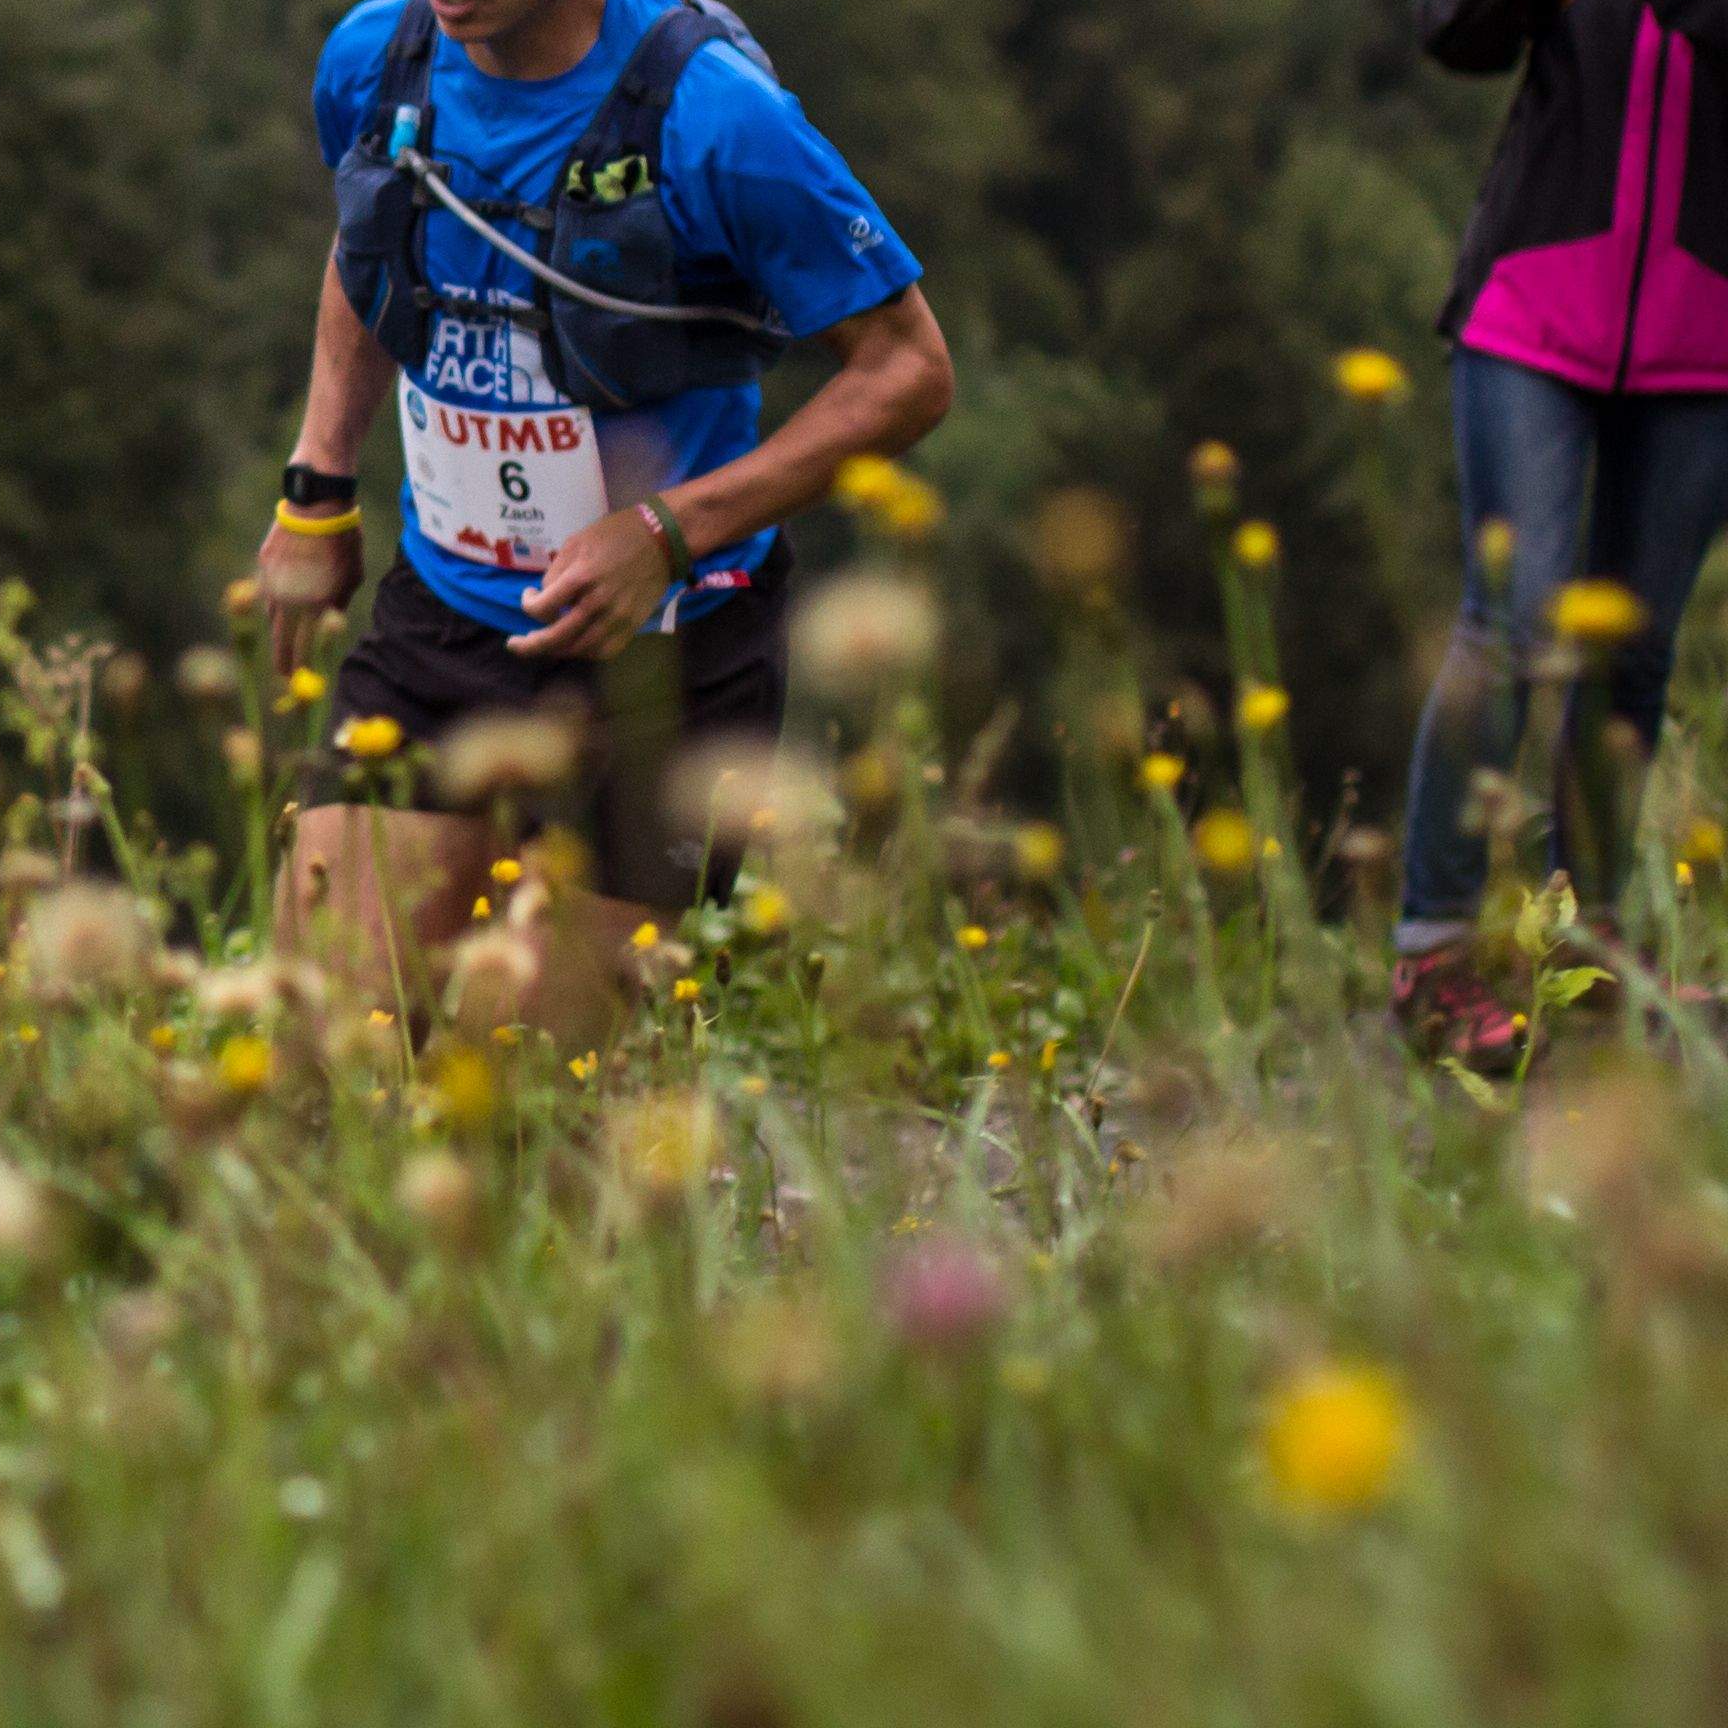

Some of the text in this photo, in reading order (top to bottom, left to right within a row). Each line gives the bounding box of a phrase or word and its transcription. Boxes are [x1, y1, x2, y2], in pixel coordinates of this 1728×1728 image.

[425, 352, 510, 403] FACE
[438, 406, 582, 453] UTMB
[499, 460, 531, 503] 6
[500, 503, 545, 521] Zach
